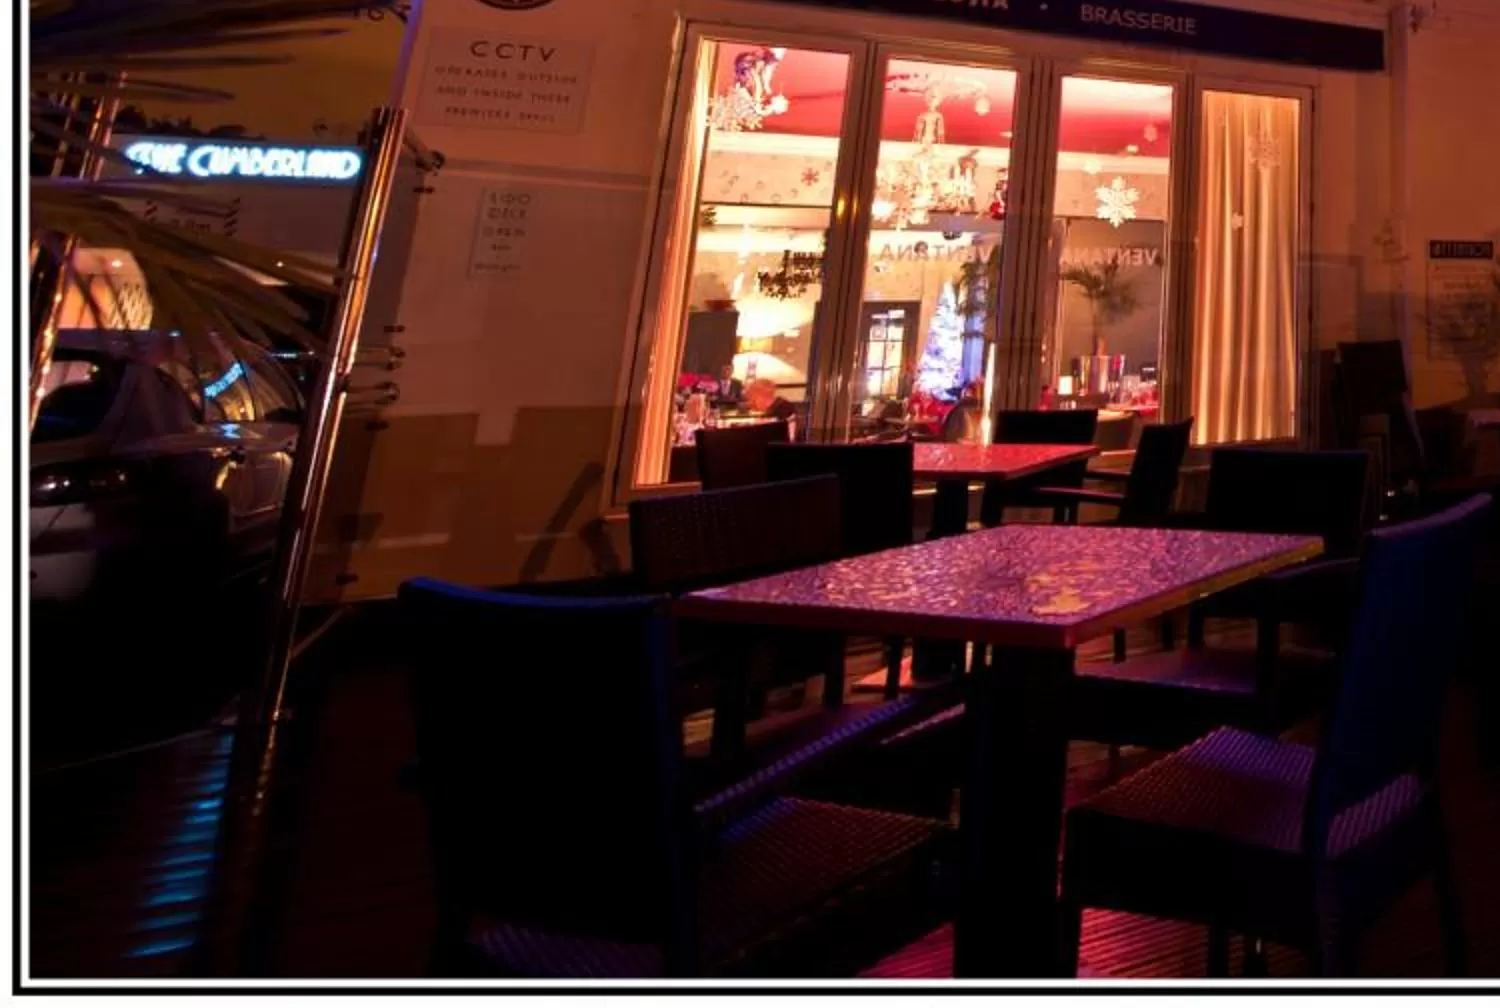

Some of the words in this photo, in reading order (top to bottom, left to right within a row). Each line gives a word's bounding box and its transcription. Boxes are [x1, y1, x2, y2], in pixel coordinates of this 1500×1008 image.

[1080, 3, 1197, 35] BRASSERIE
[469, 40, 557, 62] CCTV
[124, 142, 186, 175] THE
[188, 144, 361, 179] CUMBERLAND
